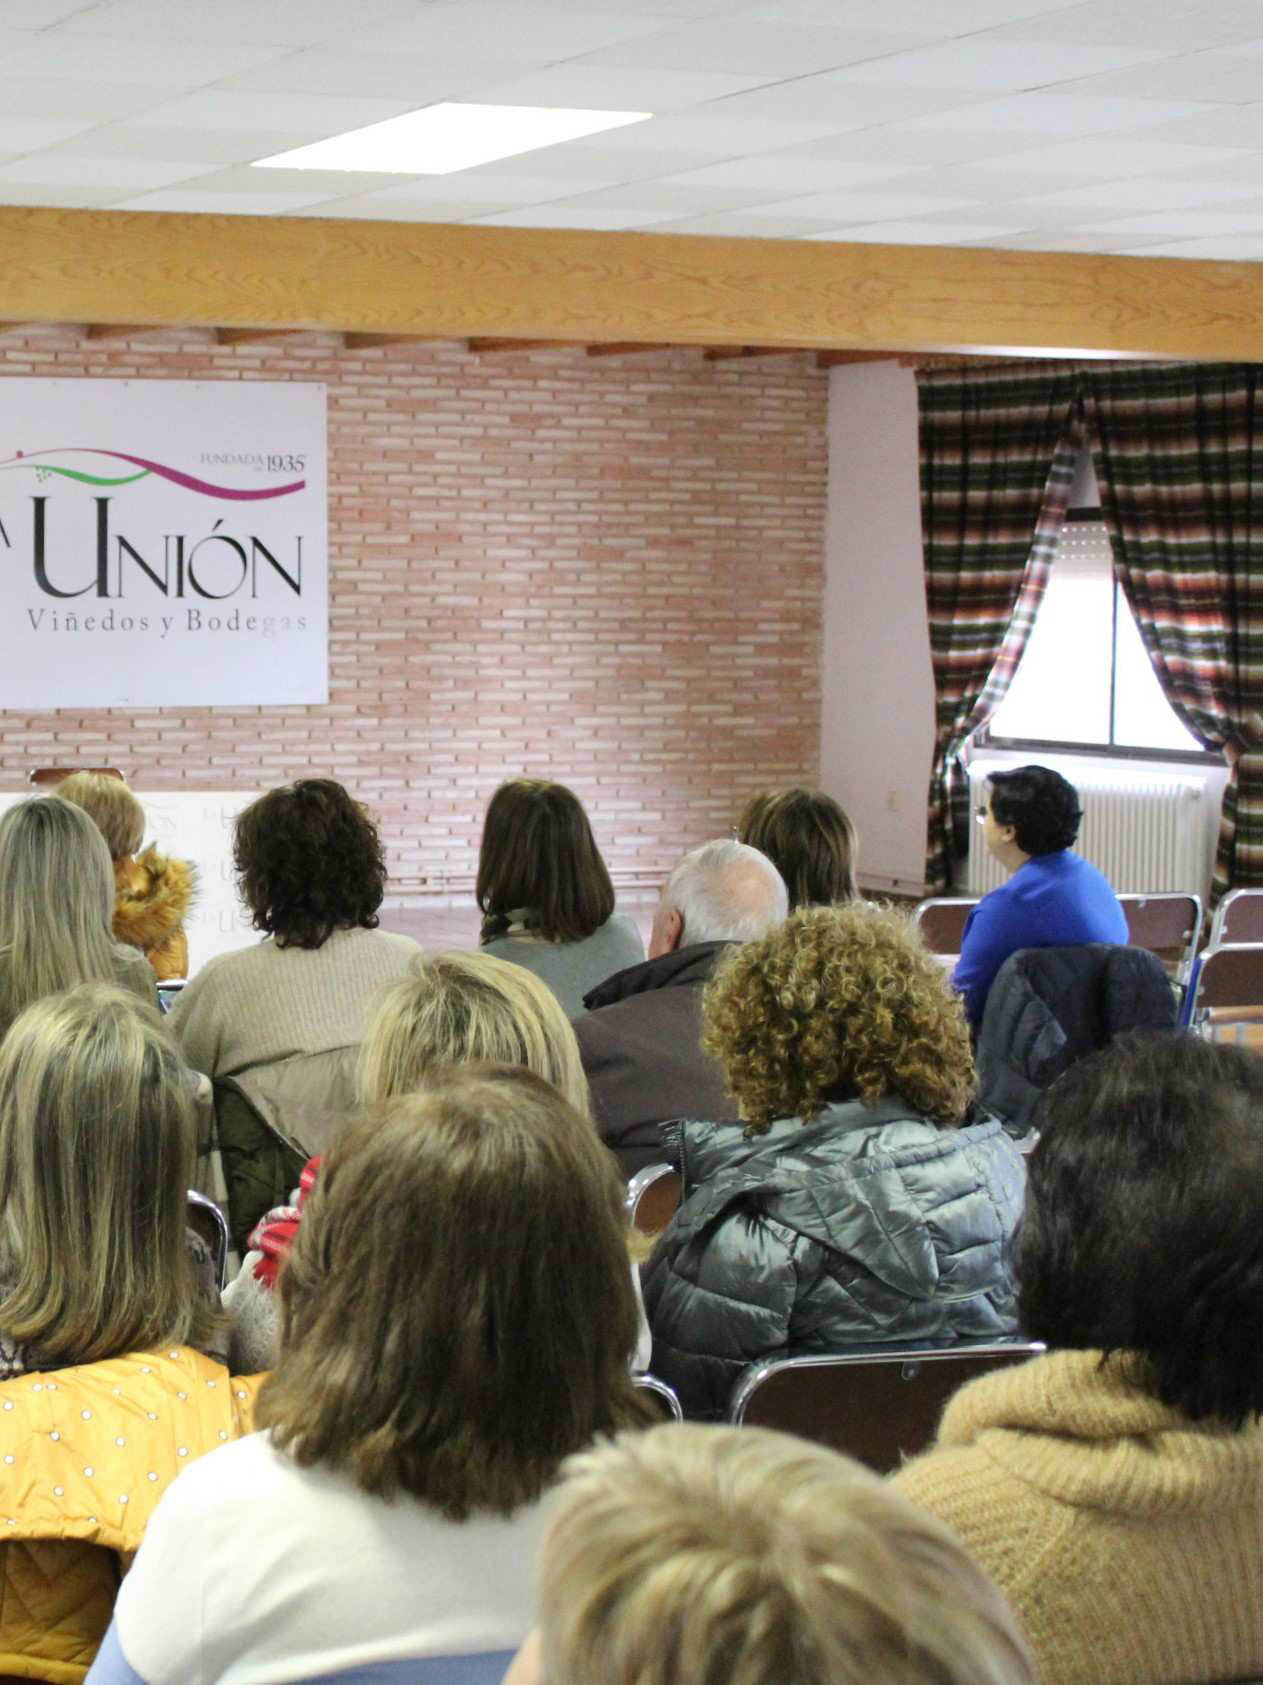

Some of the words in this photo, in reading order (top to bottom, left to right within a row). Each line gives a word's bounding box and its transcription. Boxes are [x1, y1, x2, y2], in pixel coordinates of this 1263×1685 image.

[265, 455, 306, 473] 1935
[29, 495, 306, 600] UNIÓN
[27, 608, 150, 632] Viñedos
[160, 615, 175, 639] y
[186, 608, 308, 638] Bodegas
